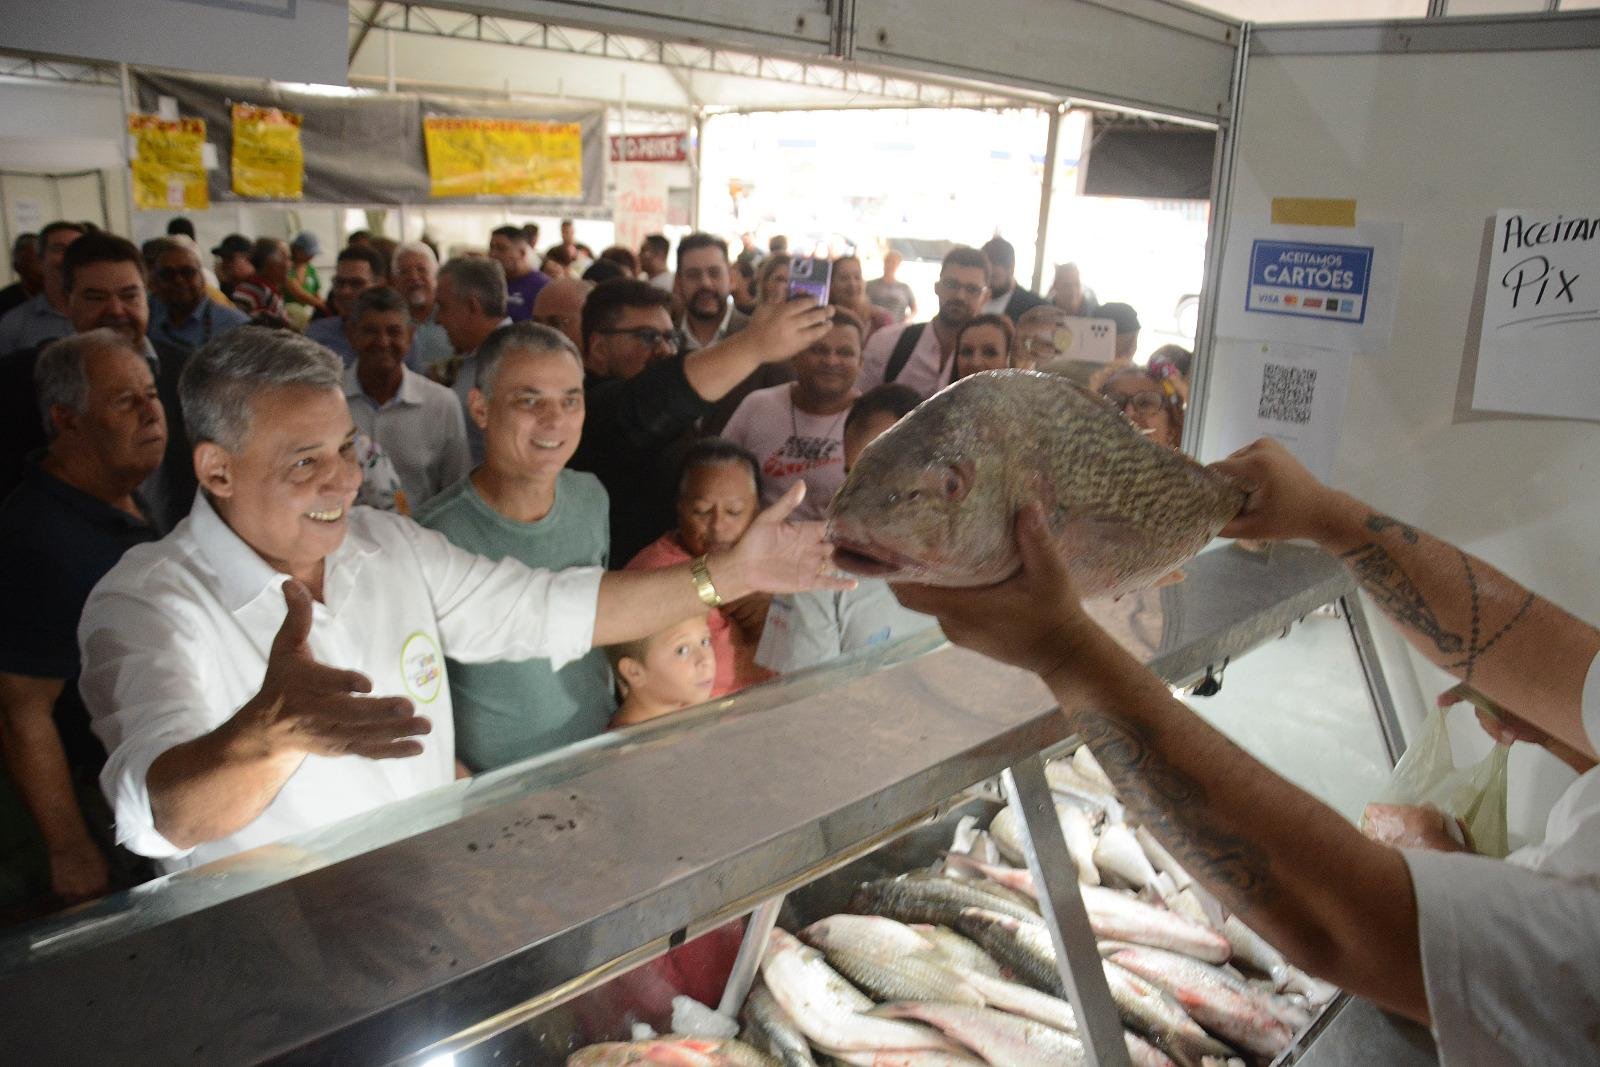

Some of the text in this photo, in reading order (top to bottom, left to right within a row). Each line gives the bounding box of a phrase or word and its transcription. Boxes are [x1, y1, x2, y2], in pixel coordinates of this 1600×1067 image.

[1278, 250, 1342, 267] ACEITAMOS
[1263, 264, 1354, 290] CARTÕES
[1259, 294, 1280, 305] VISA
